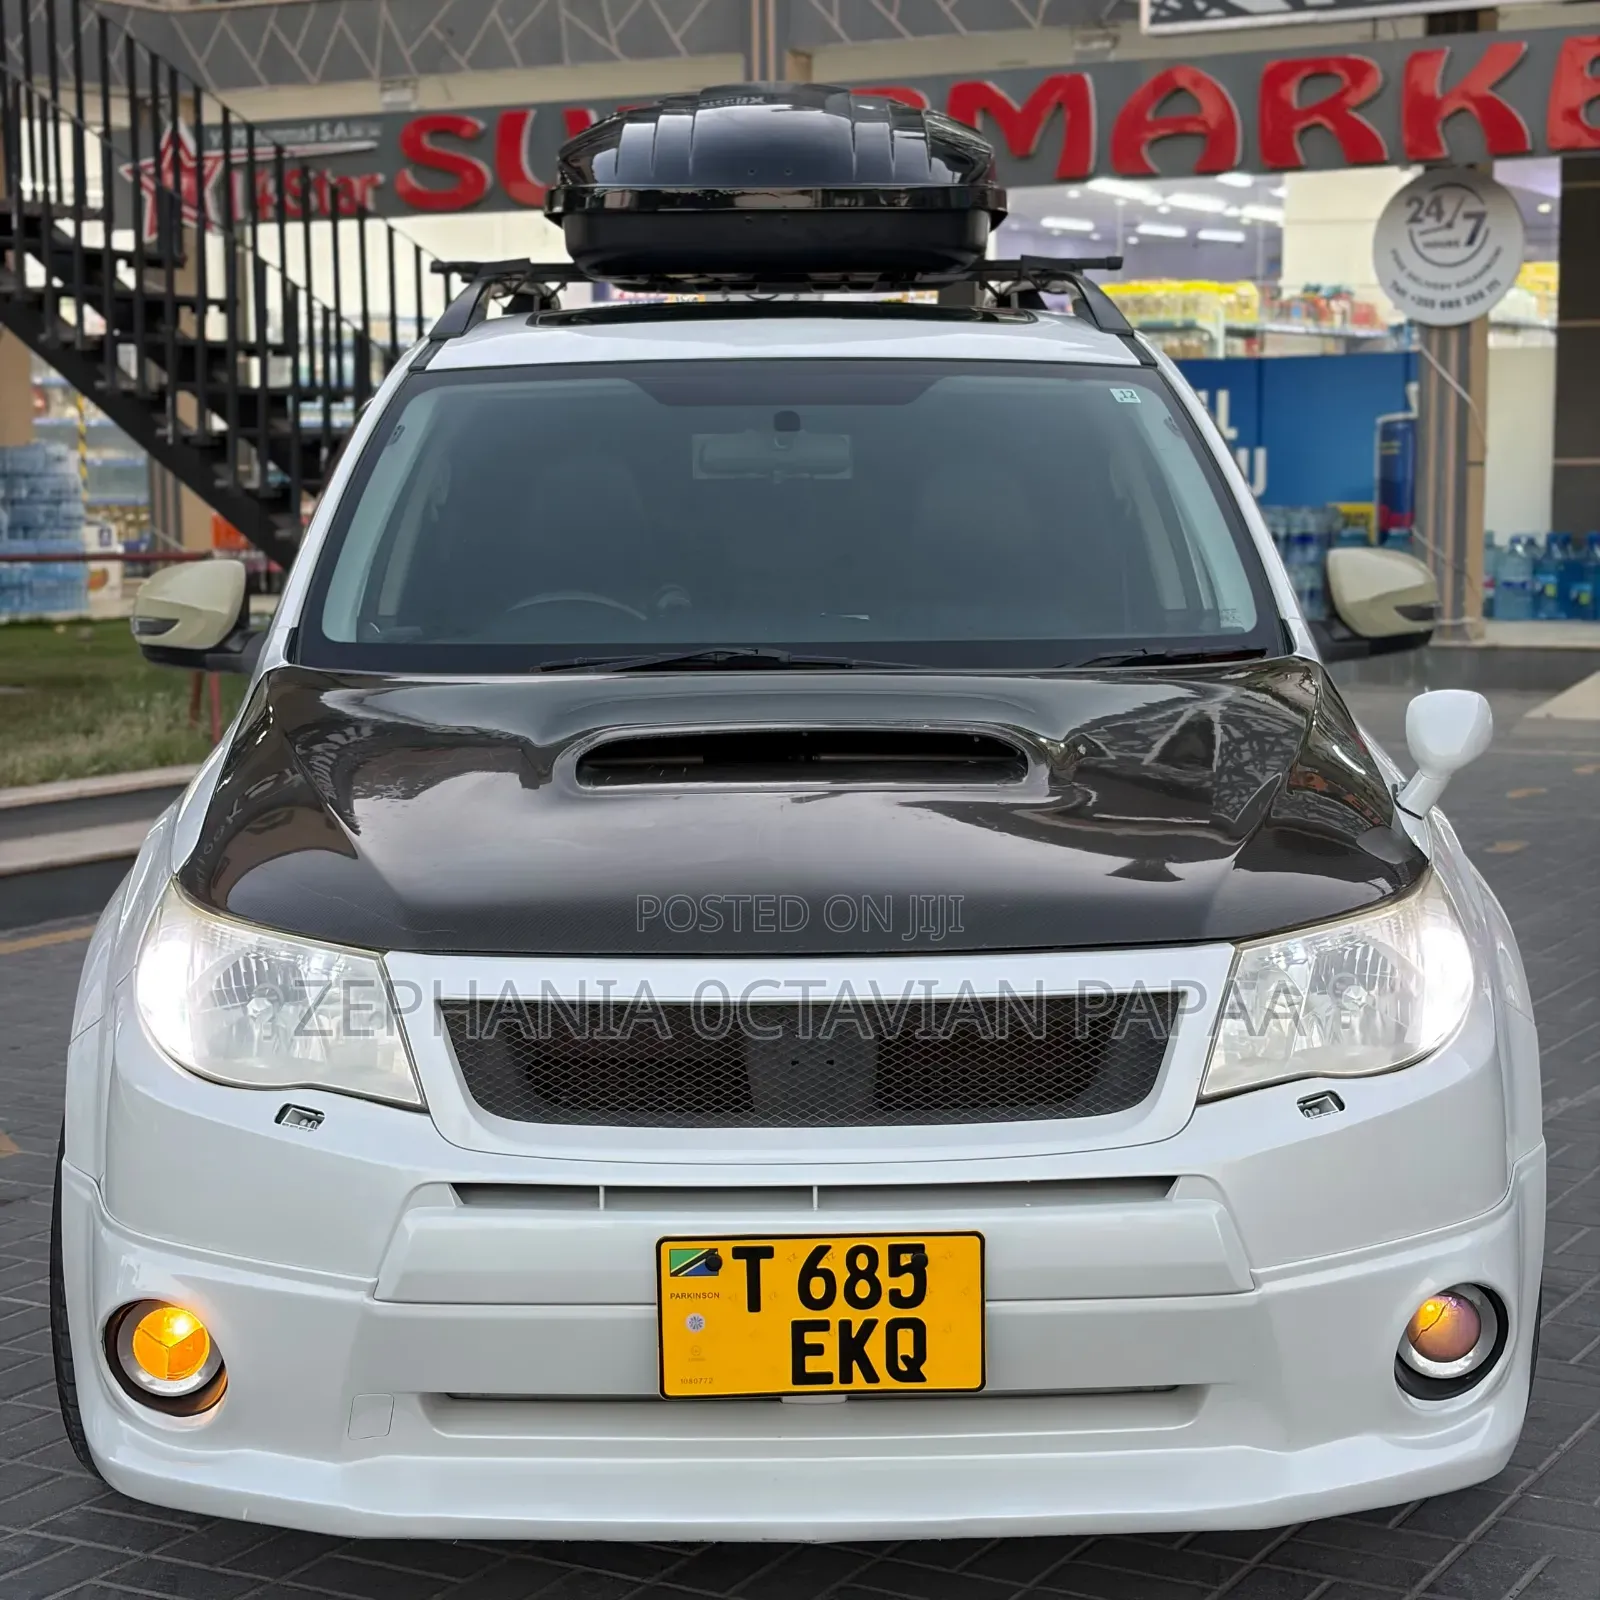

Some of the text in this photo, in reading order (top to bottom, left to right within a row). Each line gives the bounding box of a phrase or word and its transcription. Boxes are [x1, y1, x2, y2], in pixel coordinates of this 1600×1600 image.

[669, 1292, 720, 1300] PARKINSON
[732, 1243, 928, 1313] T 685
[791, 1316, 927, 1385] EKQ
